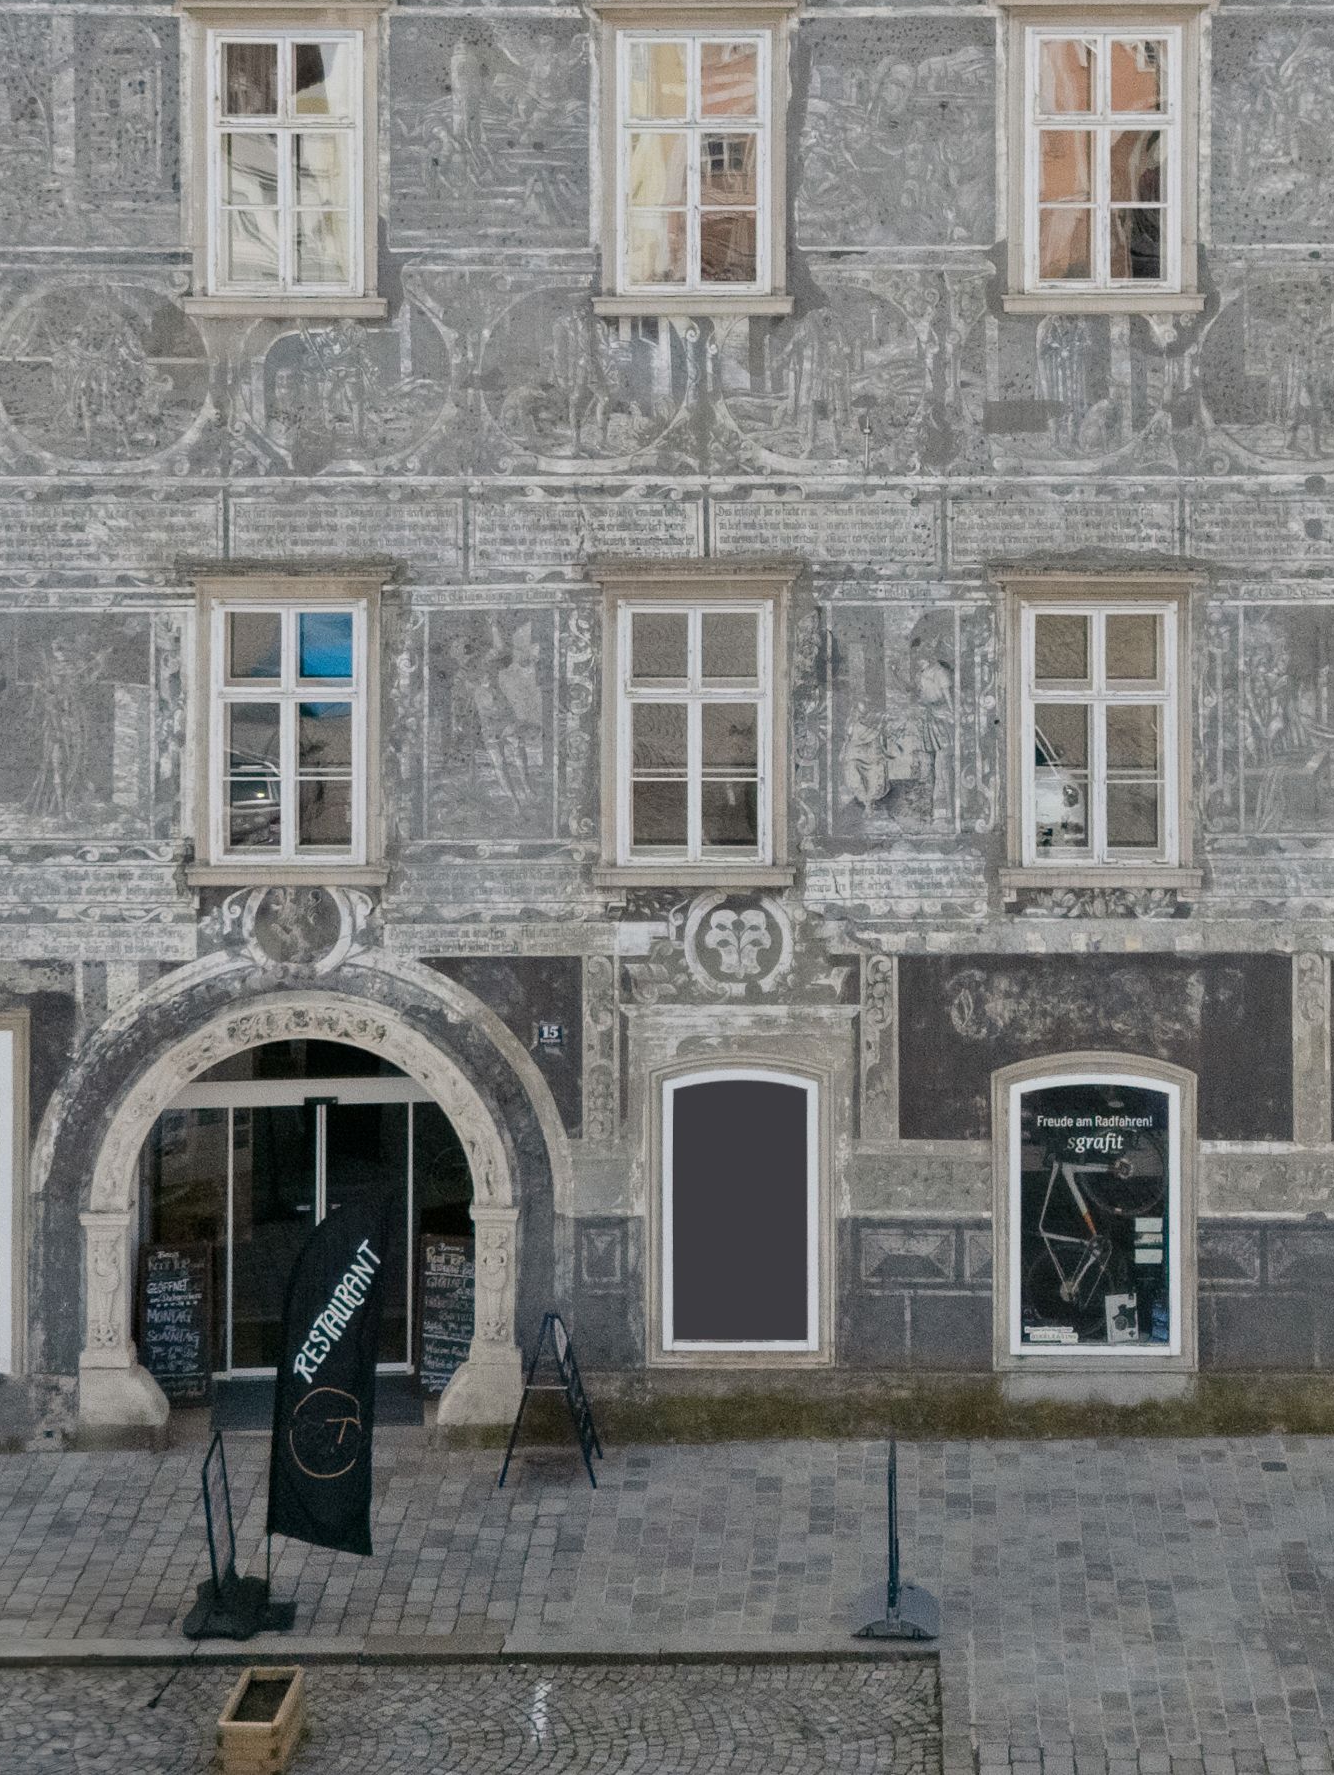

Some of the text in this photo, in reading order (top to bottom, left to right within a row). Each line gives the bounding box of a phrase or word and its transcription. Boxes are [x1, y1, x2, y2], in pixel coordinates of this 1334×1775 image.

[543, 1026, 559, 1038] 15
[1037, 1115, 1154, 1127] Freude am Radfahren!
[1067, 1133, 1124, 1153] sgrafit
[293, 1238, 381, 1384] RESTAURANT
